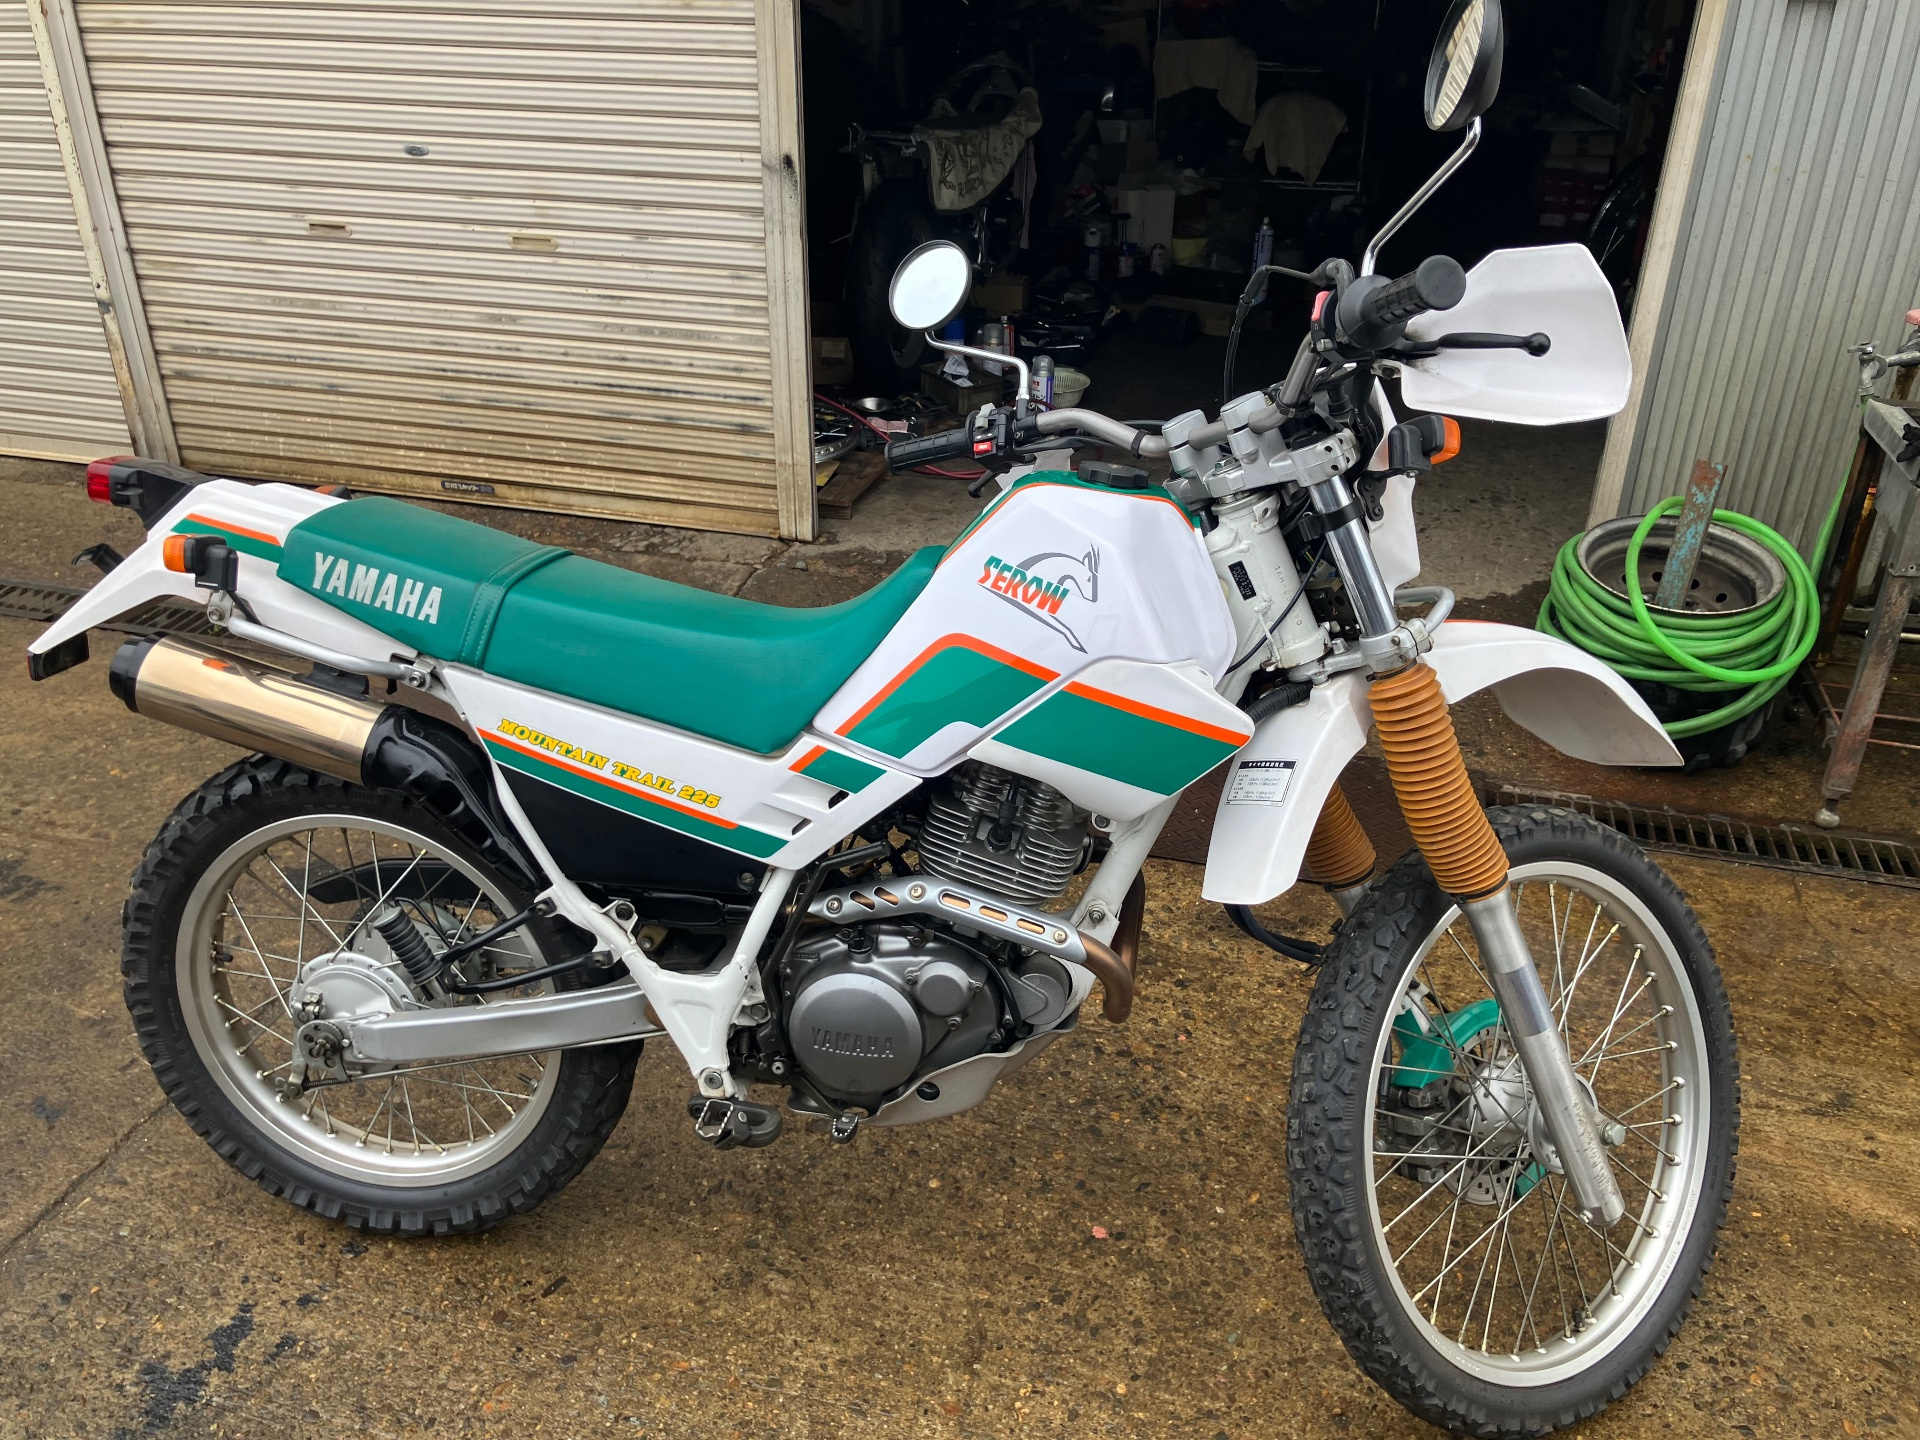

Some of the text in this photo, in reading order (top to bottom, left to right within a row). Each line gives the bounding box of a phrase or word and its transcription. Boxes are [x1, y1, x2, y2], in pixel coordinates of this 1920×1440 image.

[312, 551, 443, 625] YAMAHA
[977, 555, 1070, 615] SEROW
[496, 717, 722, 810] MOUNTAIN TRAIL 225
[811, 1026, 895, 1058] YAMAHA
